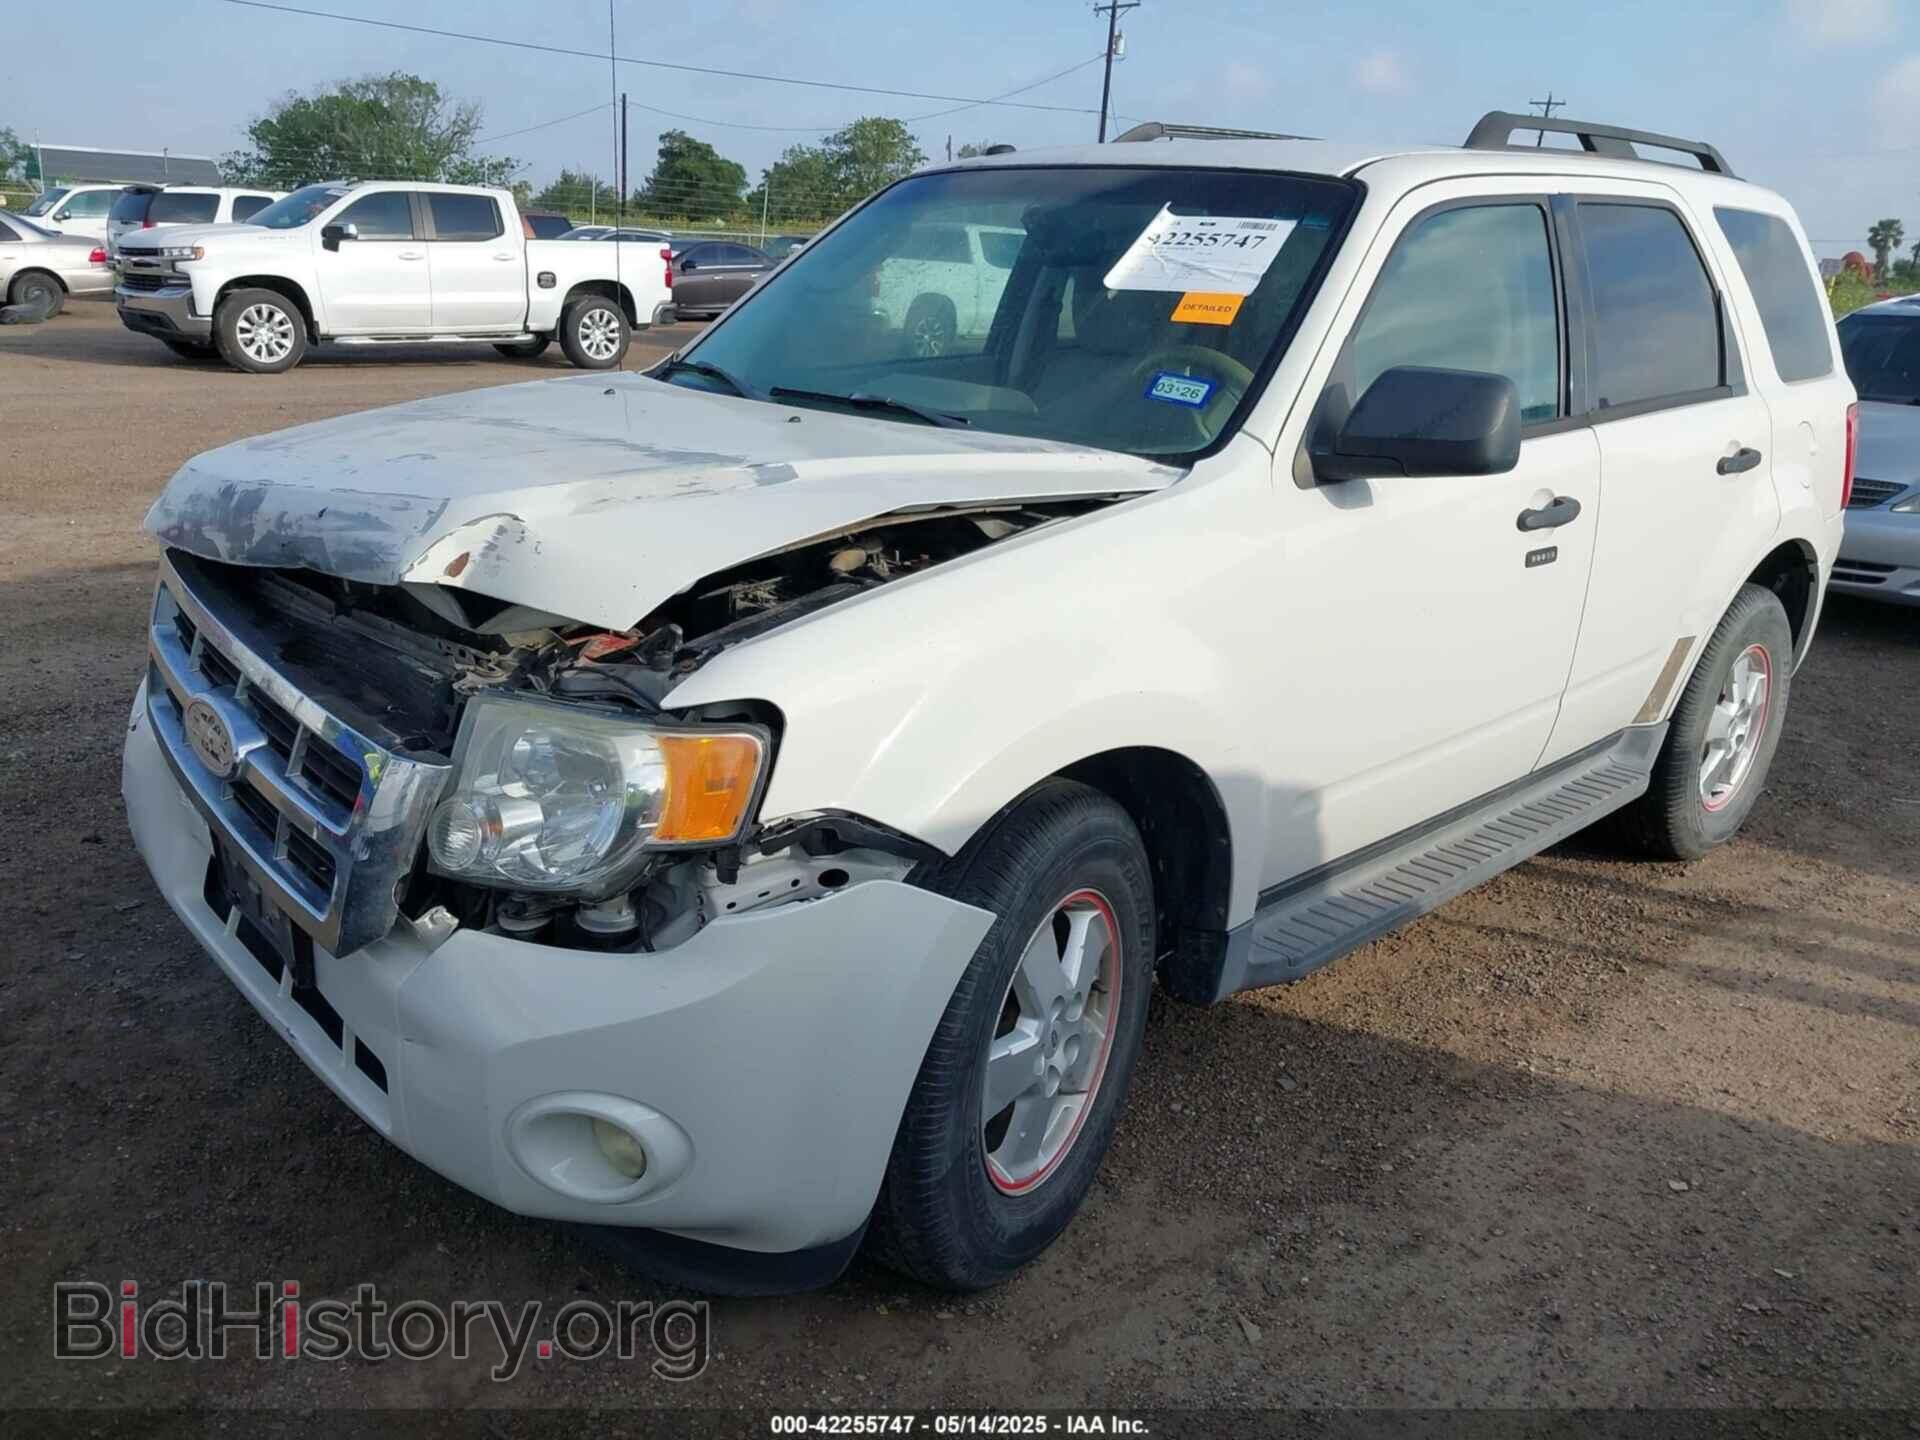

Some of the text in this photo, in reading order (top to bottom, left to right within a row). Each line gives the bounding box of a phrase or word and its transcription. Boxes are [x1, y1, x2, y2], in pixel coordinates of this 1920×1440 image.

[1182, 303, 1233, 313] DETAILED
[1155, 381, 1175, 394] 03
[1179, 386, 1201, 399] 26
